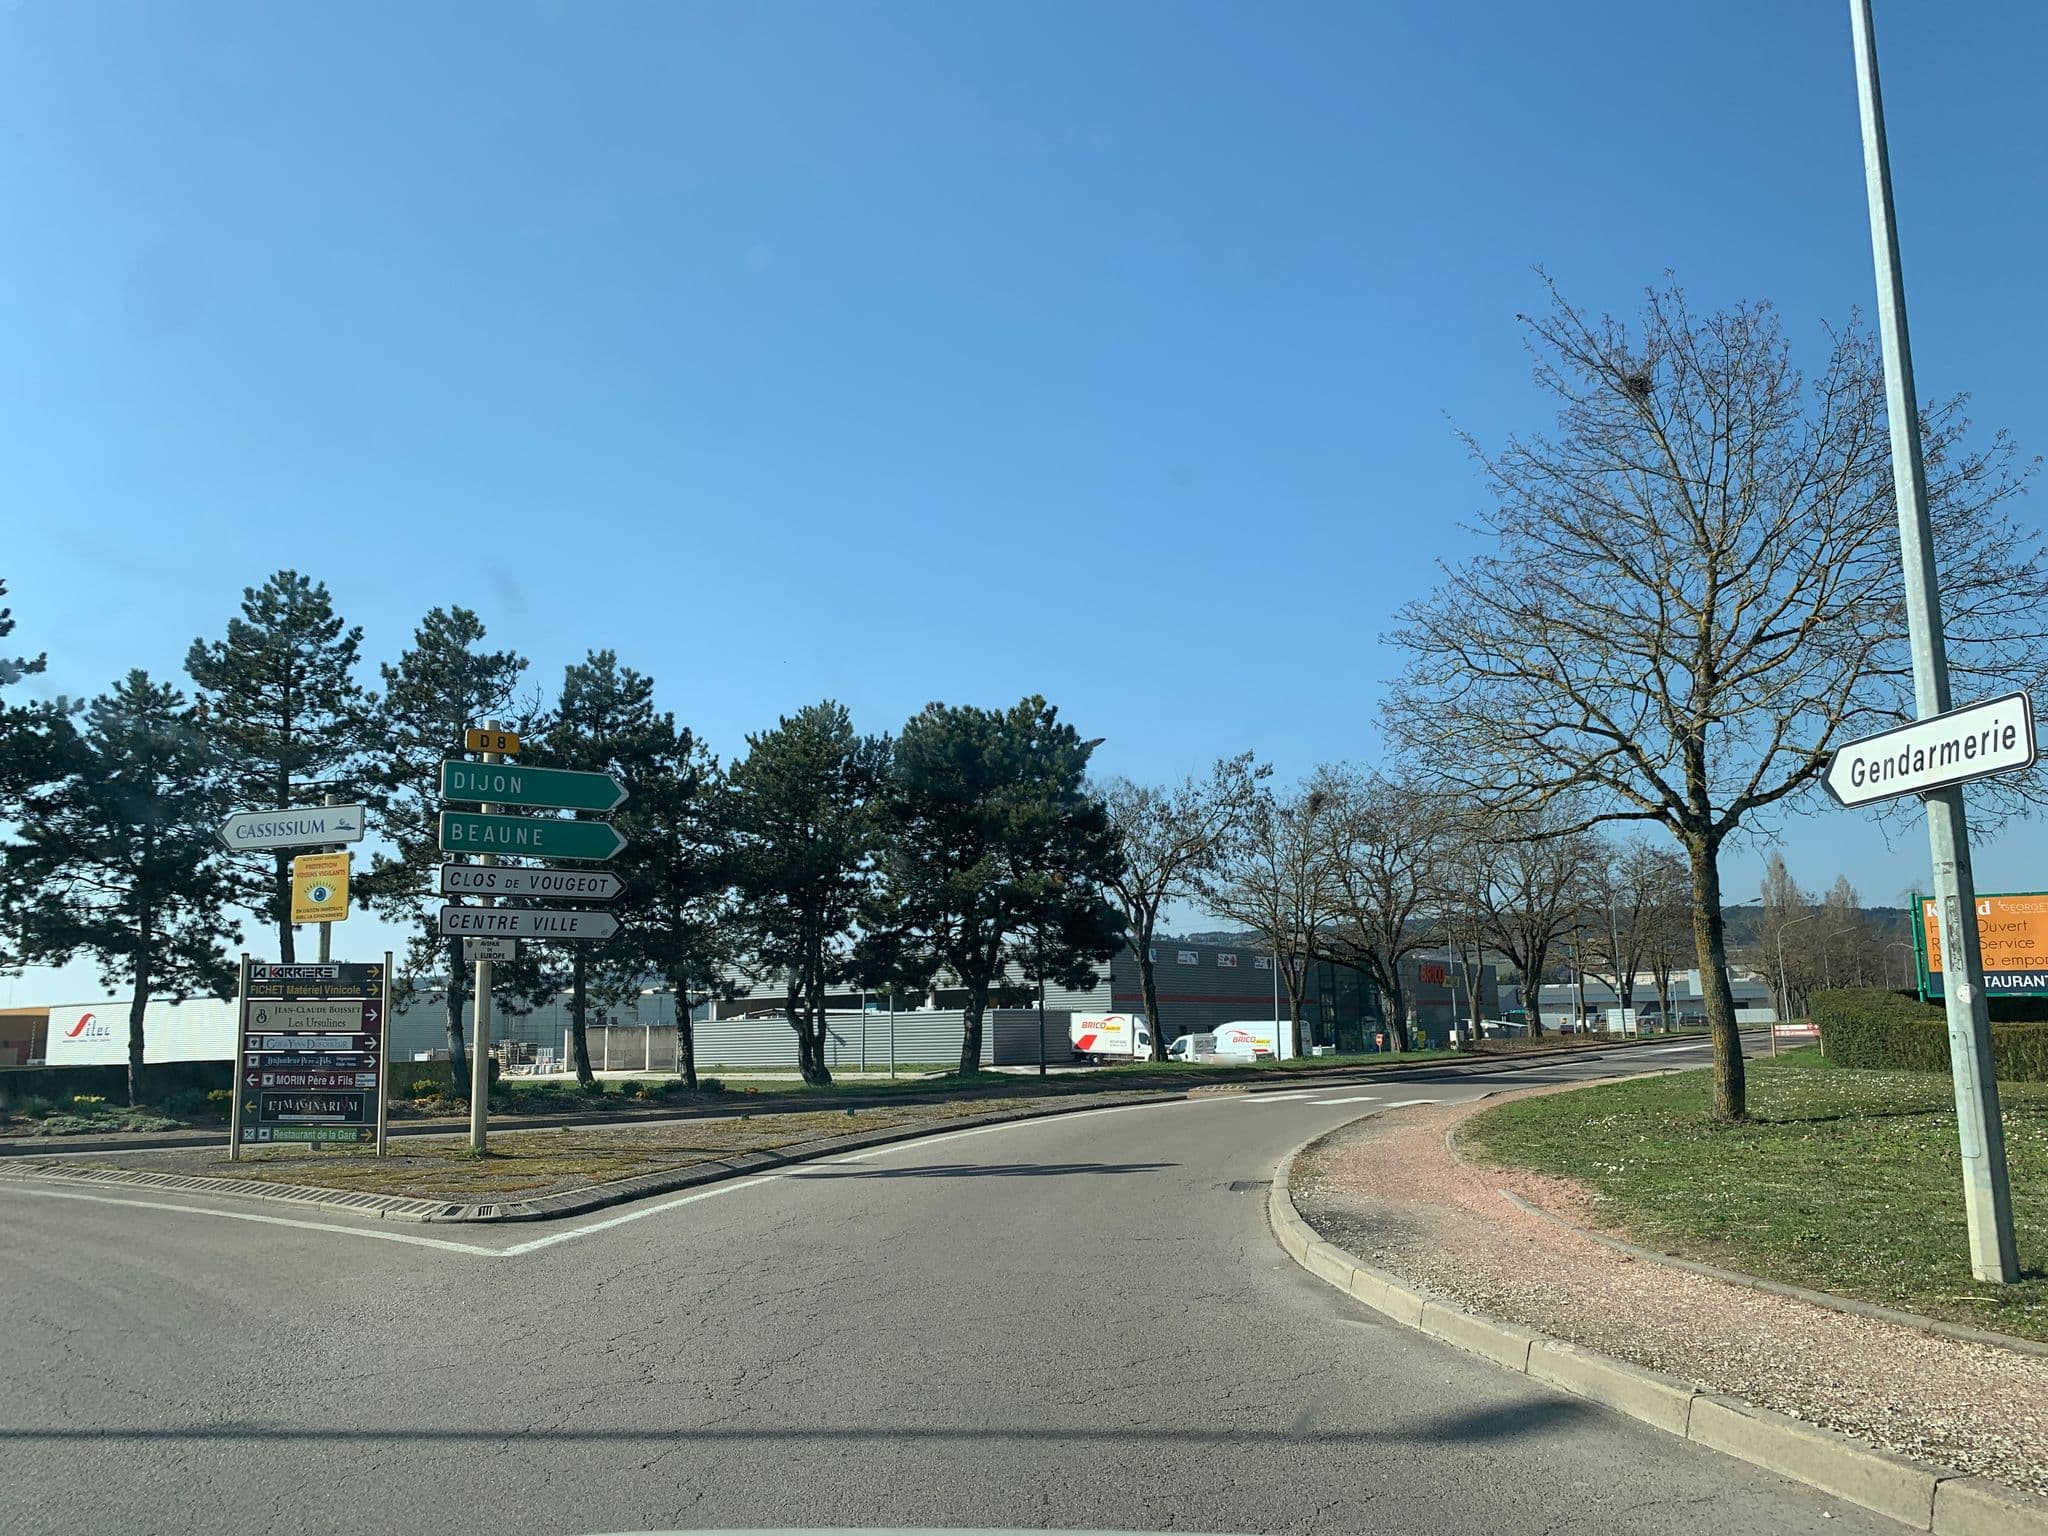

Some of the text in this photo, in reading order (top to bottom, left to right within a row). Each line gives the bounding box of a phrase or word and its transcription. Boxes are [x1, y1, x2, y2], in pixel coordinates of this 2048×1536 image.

[480, 734, 506, 750] D 8
[1851, 719, 2016, 788] Gendarmerie
[454, 772, 521, 794] DIJON
[236, 819, 325, 839] CASSISSIUM
[451, 823, 543, 846] BEAUNE
[450, 872, 609, 893] CLOS DE VOUGEOT
[449, 914, 578, 932] CENTRE VILLE
[1980, 936, 2036, 950] Service
[1984, 955, 1995, 966] à
[250, 984, 361, 995] FICHET Matériel Vinicole
[288, 1017, 346, 1028] Les Ursulines
[1082, 1021, 1107, 1030] BRICO
[276, 1075, 305, 1085] MORIN
[308, 1075, 327, 1085] Père
[328, 1076, 335, 1085] &
[337, 1075, 354, 1085] Fils
[273, 1129, 357, 1140] Restaurant de la Gare
